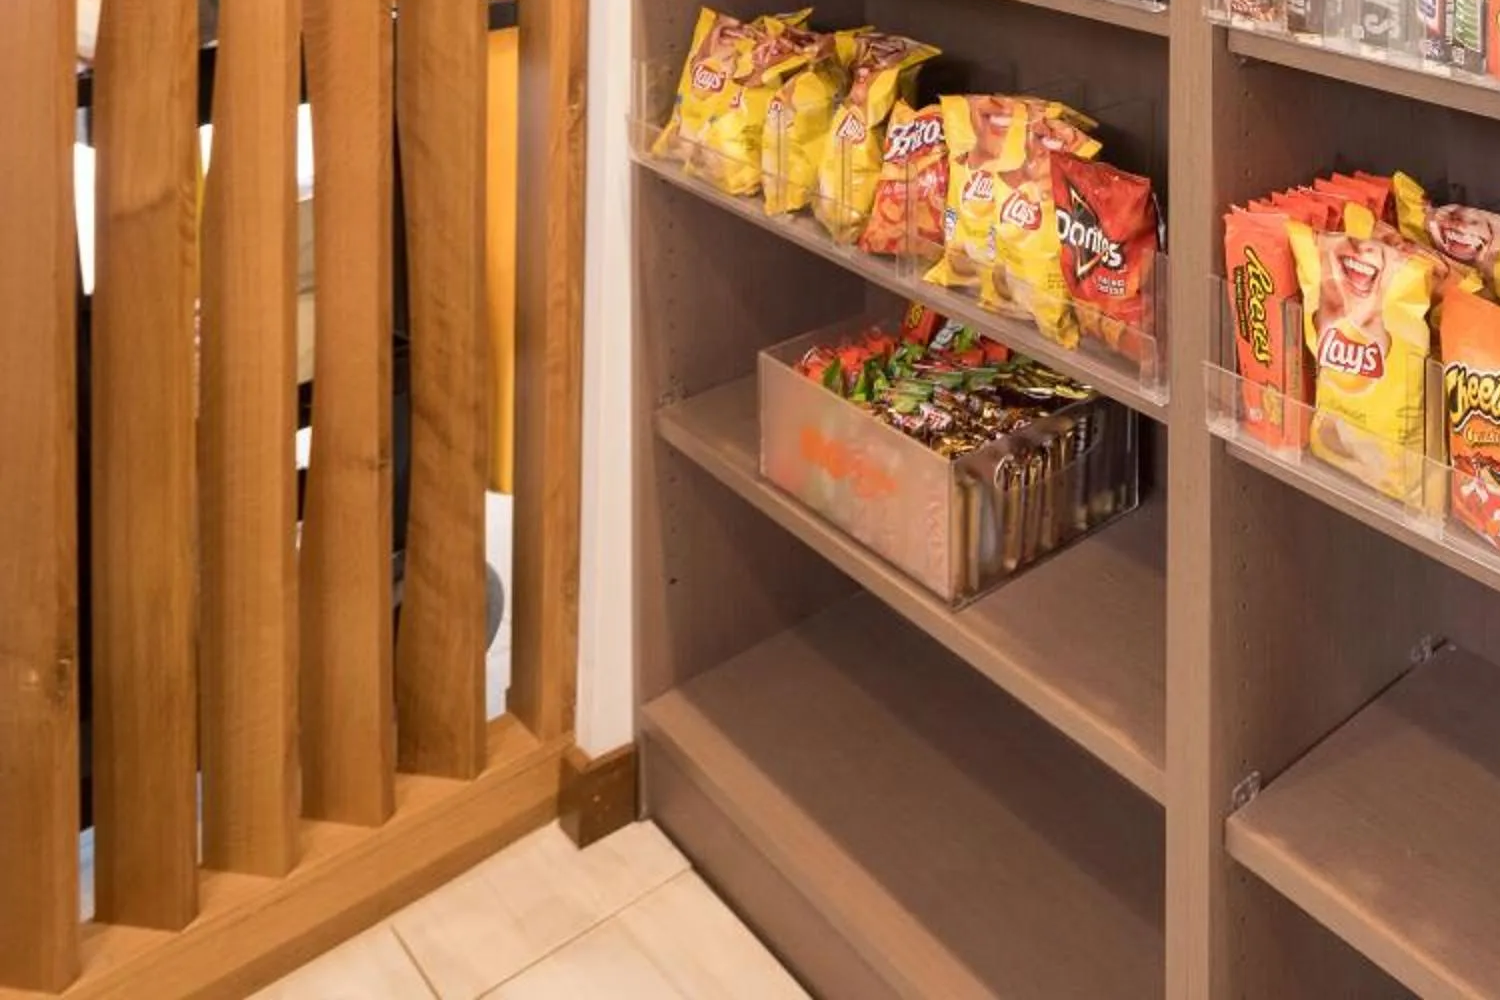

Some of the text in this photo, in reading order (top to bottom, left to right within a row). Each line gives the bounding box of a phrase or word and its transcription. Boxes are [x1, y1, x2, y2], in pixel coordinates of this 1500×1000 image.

[884, 118, 948, 161] Frito
[1055, 208, 1122, 267] Doritos
[1320, 328, 1378, 375] Lay's
